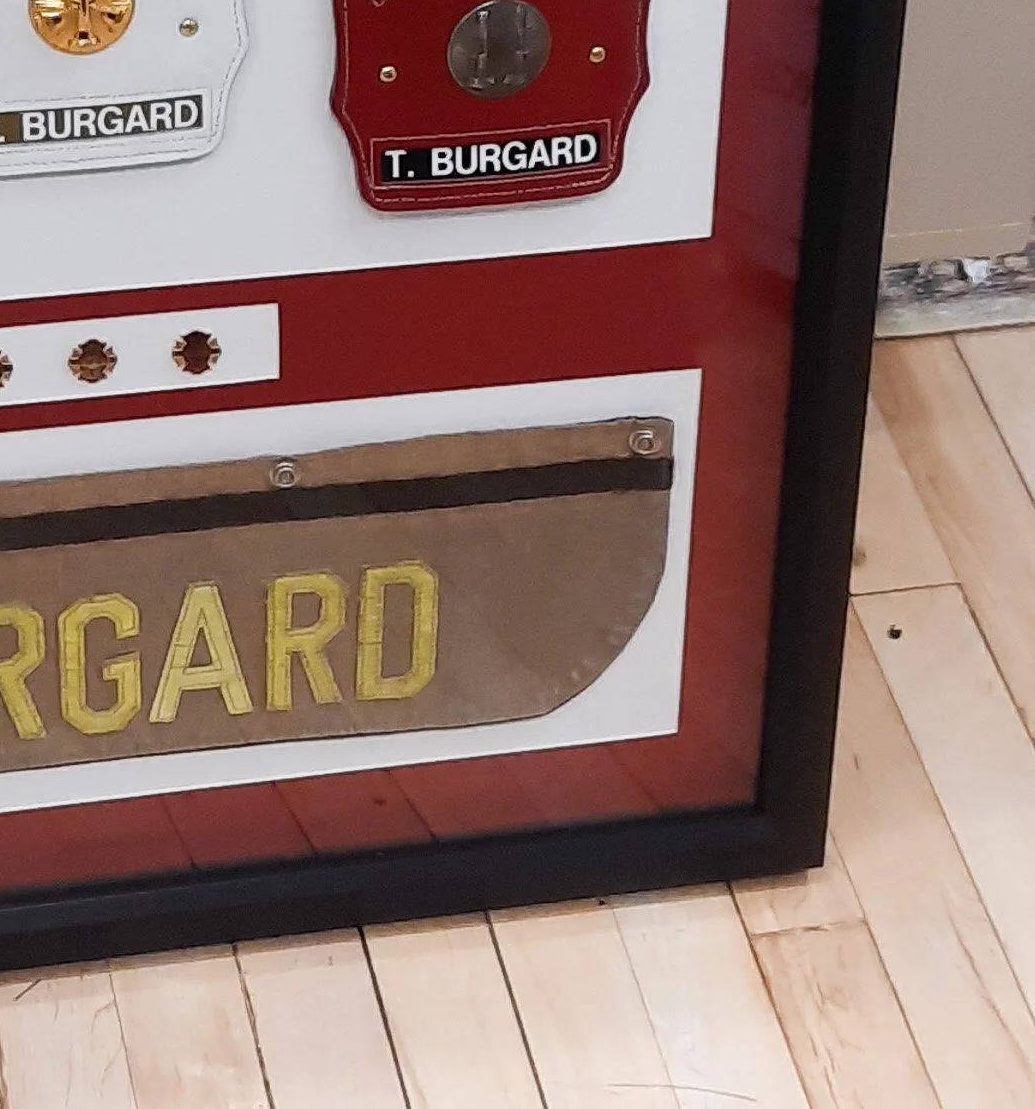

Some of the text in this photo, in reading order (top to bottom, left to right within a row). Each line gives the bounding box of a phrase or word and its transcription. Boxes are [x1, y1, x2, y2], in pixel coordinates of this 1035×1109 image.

[22, 98, 199, 141] BURGARD
[384, 133, 597, 178] T. BURGARD
